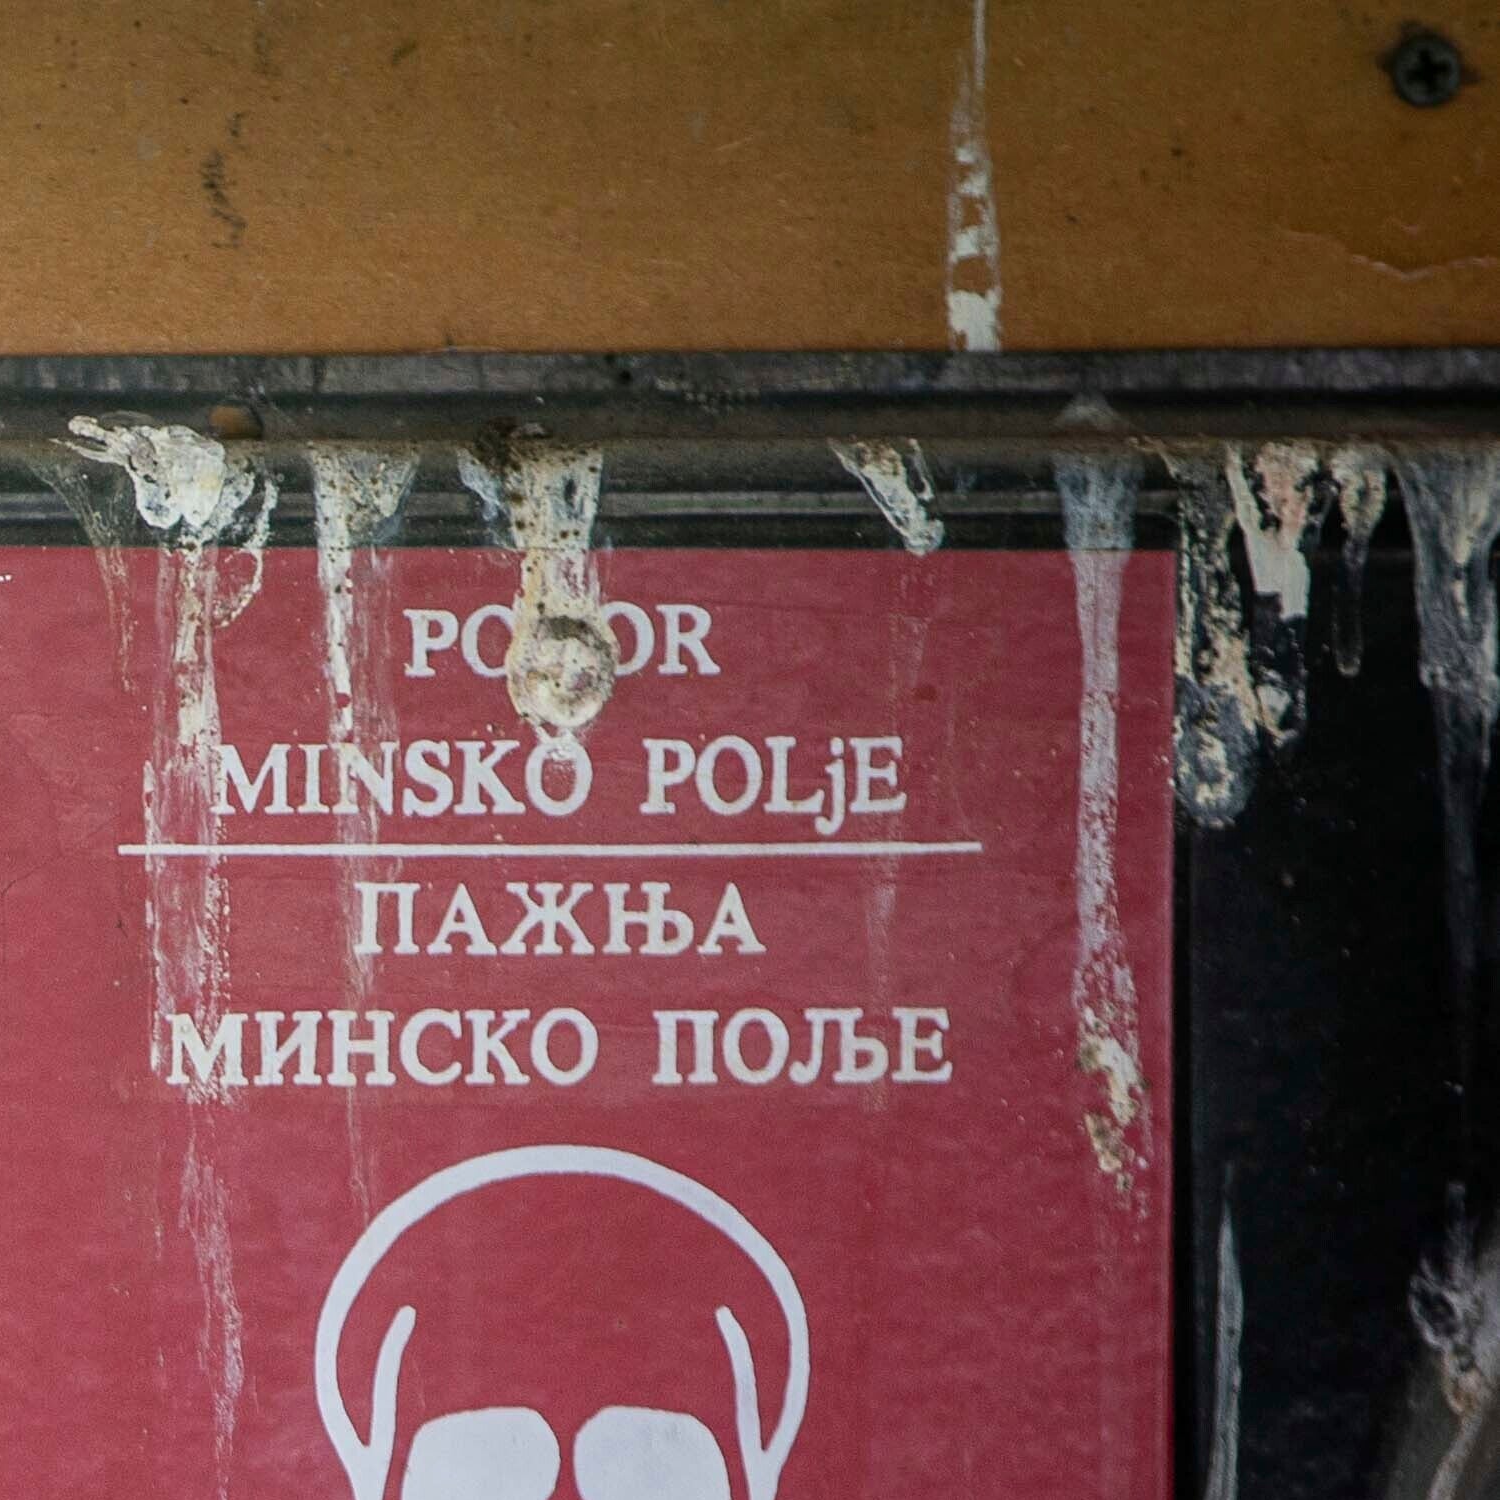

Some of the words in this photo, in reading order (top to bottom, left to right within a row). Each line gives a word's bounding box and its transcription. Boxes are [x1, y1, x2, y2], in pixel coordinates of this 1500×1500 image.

[403, 602, 721, 678] POOR
[210, 739, 593, 817] MINSKO
[353, 881, 766, 956] ПАЖЊА
[166, 1008, 600, 1086] МИНСКО
[652, 1006, 954, 1086] ПОЉЕ
